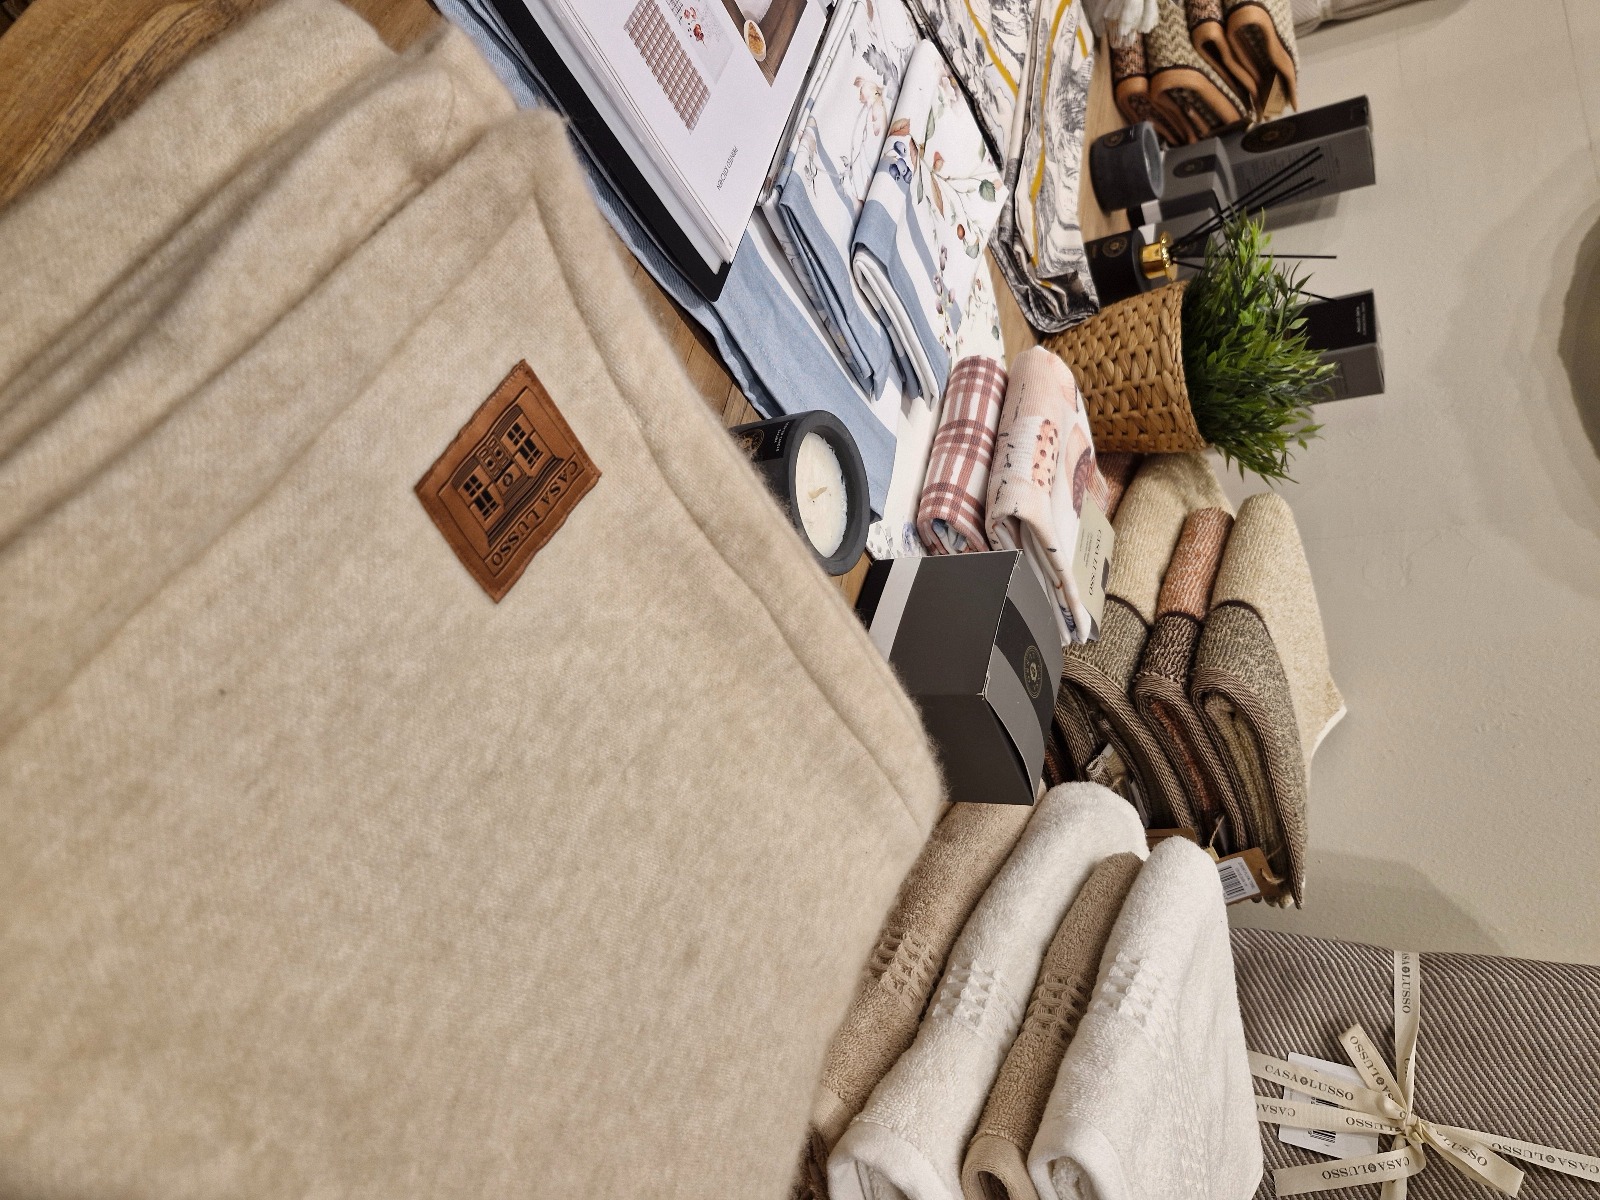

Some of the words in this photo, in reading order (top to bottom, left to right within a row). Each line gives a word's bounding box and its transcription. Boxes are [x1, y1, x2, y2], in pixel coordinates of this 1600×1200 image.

[541, 461, 578, 505] CASA
[492, 509, 540, 566] LUSSO
[1088, 558, 1097, 596] LUSSO
[1401, 974, 1411, 1014] LUSSO
[1350, 1035, 1379, 1079] LUSSO
[1264, 1064, 1299, 1083] CASA
[1308, 1079, 1354, 1101] LUSSO
[1259, 1103, 1296, 1117] CASA
[1321, 1164, 1366, 1180] LUSSO
[1378, 1156, 1410, 1172] CASA
[1557, 1157, 1600, 1174] CASA
